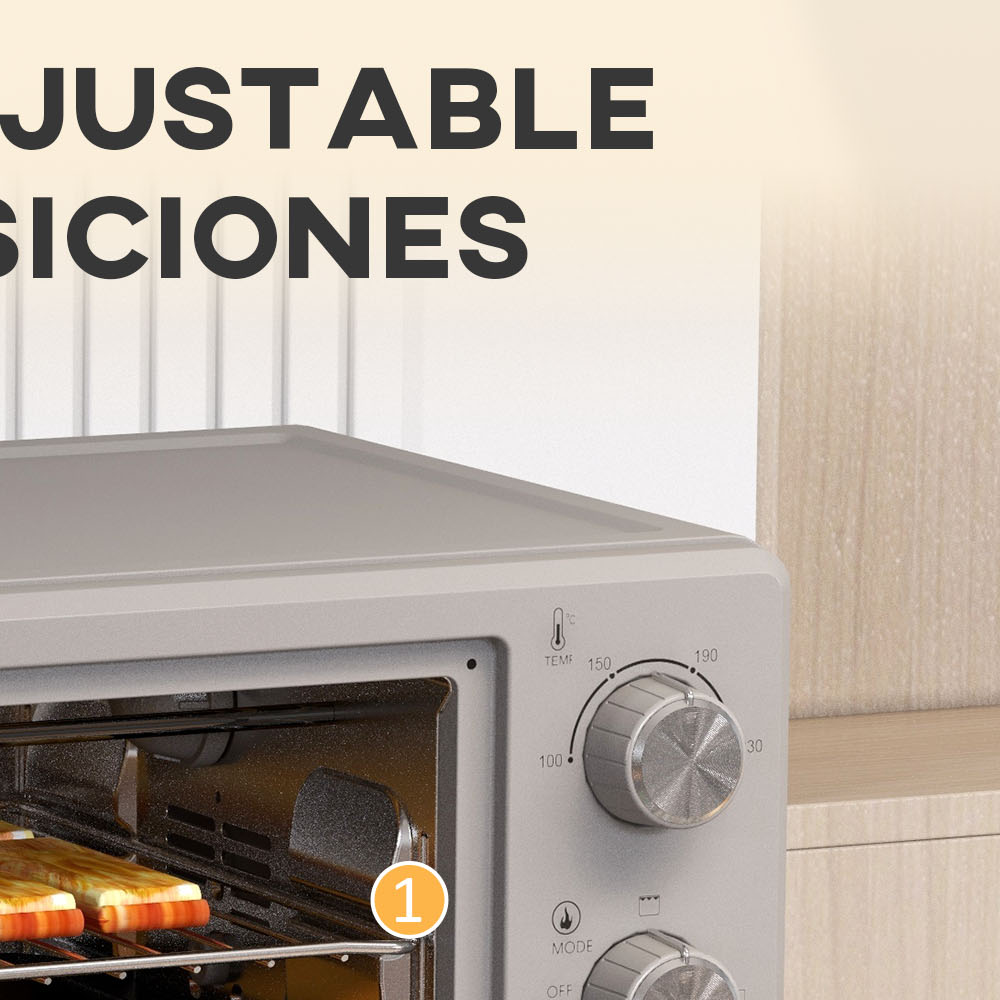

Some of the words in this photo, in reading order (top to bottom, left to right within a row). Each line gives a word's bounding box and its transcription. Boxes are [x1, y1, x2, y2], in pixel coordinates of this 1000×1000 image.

[695, 648, 718, 662] 190
[588, 656, 612, 671] 150
[745, 739, 763, 753] 30
[539, 754, 563, 768] 100
[552, 939, 593, 955] MODE
[547, 984, 573, 998] OFF
